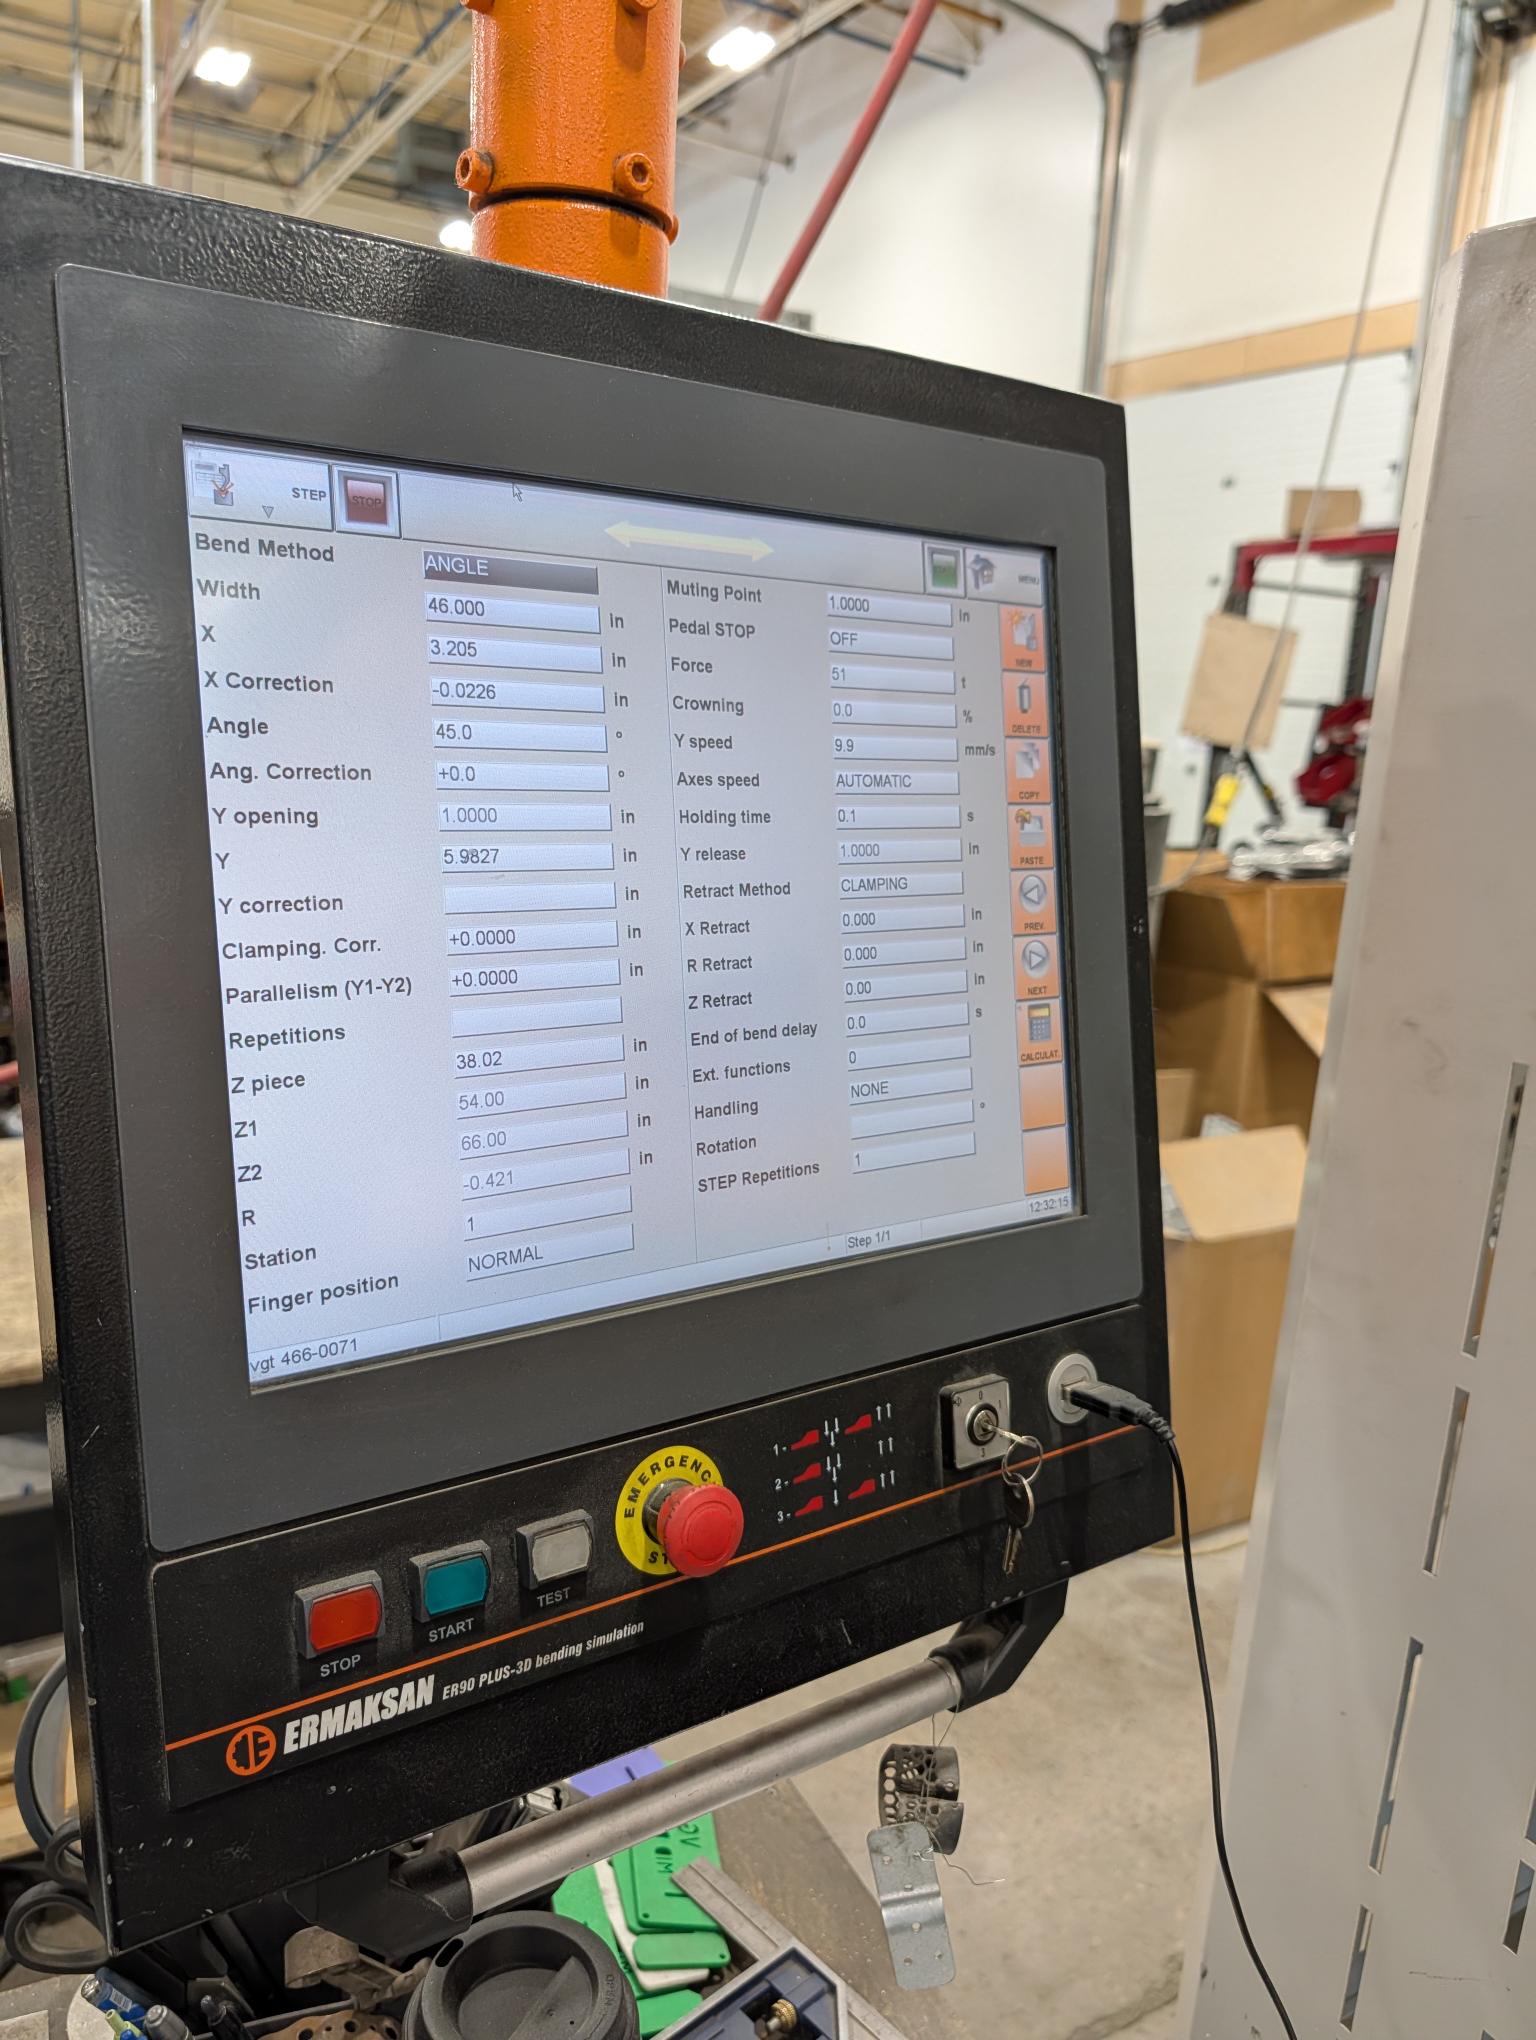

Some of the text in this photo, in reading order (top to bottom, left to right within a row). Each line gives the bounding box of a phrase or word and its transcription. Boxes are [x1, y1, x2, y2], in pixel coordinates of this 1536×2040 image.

[292, 487, 327, 502] STEP
[352, 495, 382, 507] STOP
[195, 532, 334, 562] Bend Method
[425, 555, 489, 576] ANGLE
[196, 578, 260, 600] Width
[667, 580, 762, 603] Muting Point
[428, 597, 485, 617] 46.000
[830, 595, 869, 613] 1.0000
[610, 613, 624, 629] in
[959, 609, 970, 623] in
[201, 625, 216, 642] X
[669, 618, 755, 639] Pedal STOP
[830, 631, 858, 646] OFF
[430, 639, 477, 657] 3.205
[612, 653, 626, 668] in
[671, 657, 713, 674] Force
[204, 671, 334, 693] X Correction
[832, 667, 846, 681] 51
[433, 682, 496, 700] -0.0226
[614, 692, 628, 707] in
[673, 696, 744, 716] Crowning
[833, 703, 853, 717] 0.0
[207, 717, 269, 738] Angle
[436, 724, 472, 740] 45.0
[1012, 724, 1041, 734] DELETE
[674, 733, 733, 752] Y speed
[835, 738, 854, 752] 9.9
[965, 744, 995, 756] mm/s
[210, 762, 372, 784] Ang. Correction
[439, 766, 476, 782] +0.0
[677, 772, 760, 790] Axes speed
[836, 774, 912, 788] AUTOMATIC
[1019, 791, 1040, 799] COPY
[212, 808, 319, 828] Y opening
[442, 807, 497, 823] 1.0000
[621, 809, 635, 824] in
[679, 810, 771, 827] Holding time
[838, 809, 856, 823] 0.1
[444, 848, 499, 864] 5.9827
[623, 848, 637, 862] in
[681, 847, 746, 861] Y release
[840, 844, 880, 858] 1.0000
[969, 843, 979, 855] in
[215, 853, 230, 870] Y
[1020, 856, 1044, 865] PASTE
[683, 882, 791, 899] Retract Method
[841, 877, 908, 892] CLAMPING
[625, 887, 639, 901] in
[219, 895, 343, 914] Y correction
[842, 913, 875, 927] 0.000
[972, 908, 982, 920] in
[627, 925, 641, 939] in
[685, 920, 750, 936] X Retract
[450, 929, 516, 946] +0.0000
[222, 938, 381, 961] Clamping. Corr.
[844, 947, 877, 961] 0.000
[973, 941, 983, 952] in
[629, 963, 643, 977] in
[687, 956, 753, 973] R Retract
[452, 969, 518, 987] +0.0000
[974, 973, 985, 985] in
[226, 977, 412, 1004] Parallelism (Y1-Y2)
[846, 981, 872, 996] 0.00
[1028, 986, 1047, 995] NEXT
[689, 992, 753, 1010] Z Retract
[847, 1016, 866, 1029] 0.0
[229, 1027, 346, 1051] Repetitions
[691, 1023, 818, 1046] End of bend delay
[634, 1038, 647, 1052] in
[457, 1051, 502, 1069] 38.02
[849, 1051, 856, 1064] 0
[693, 1060, 791, 1083] Ext. functions
[231, 1074, 305, 1096] Z piece
[635, 1076, 649, 1090] in
[851, 1081, 889, 1098] NONE
[459, 1091, 505, 1110] 54.00
[695, 1101, 759, 1119] Handling
[234, 1120, 257, 1138] Z1
[638, 1114, 651, 1128] in
[461, 1131, 507, 1150] 66.00
[696, 1137, 757, 1156] Rotation
[639, 1152, 653, 1165] in
[855, 1154, 860, 1166] 1
[238, 1164, 262, 1182] Z2
[464, 1170, 514, 1190] -0.421
[698, 1162, 820, 1192] STEP Repetitions
[242, 1210, 256, 1226] R
[468, 1217, 474, 1232] 1
[848, 1230, 891, 1249] Step 1/1
[245, 1247, 316, 1270] Station
[468, 1246, 544, 1272] NORMAL
[249, 1275, 399, 1314] Finger position
[250, 1338, 358, 1374] vgt 466-0071
[624, 1455, 716, 1518] EMERGENC
[537, 1586, 571, 1609] TEST
[429, 1618, 475, 1643] START
[320, 1655, 361, 1678] STOP
[283, 1621, 644, 1754] ERMAKSAN ER90 PLUS-3D bending simulation
